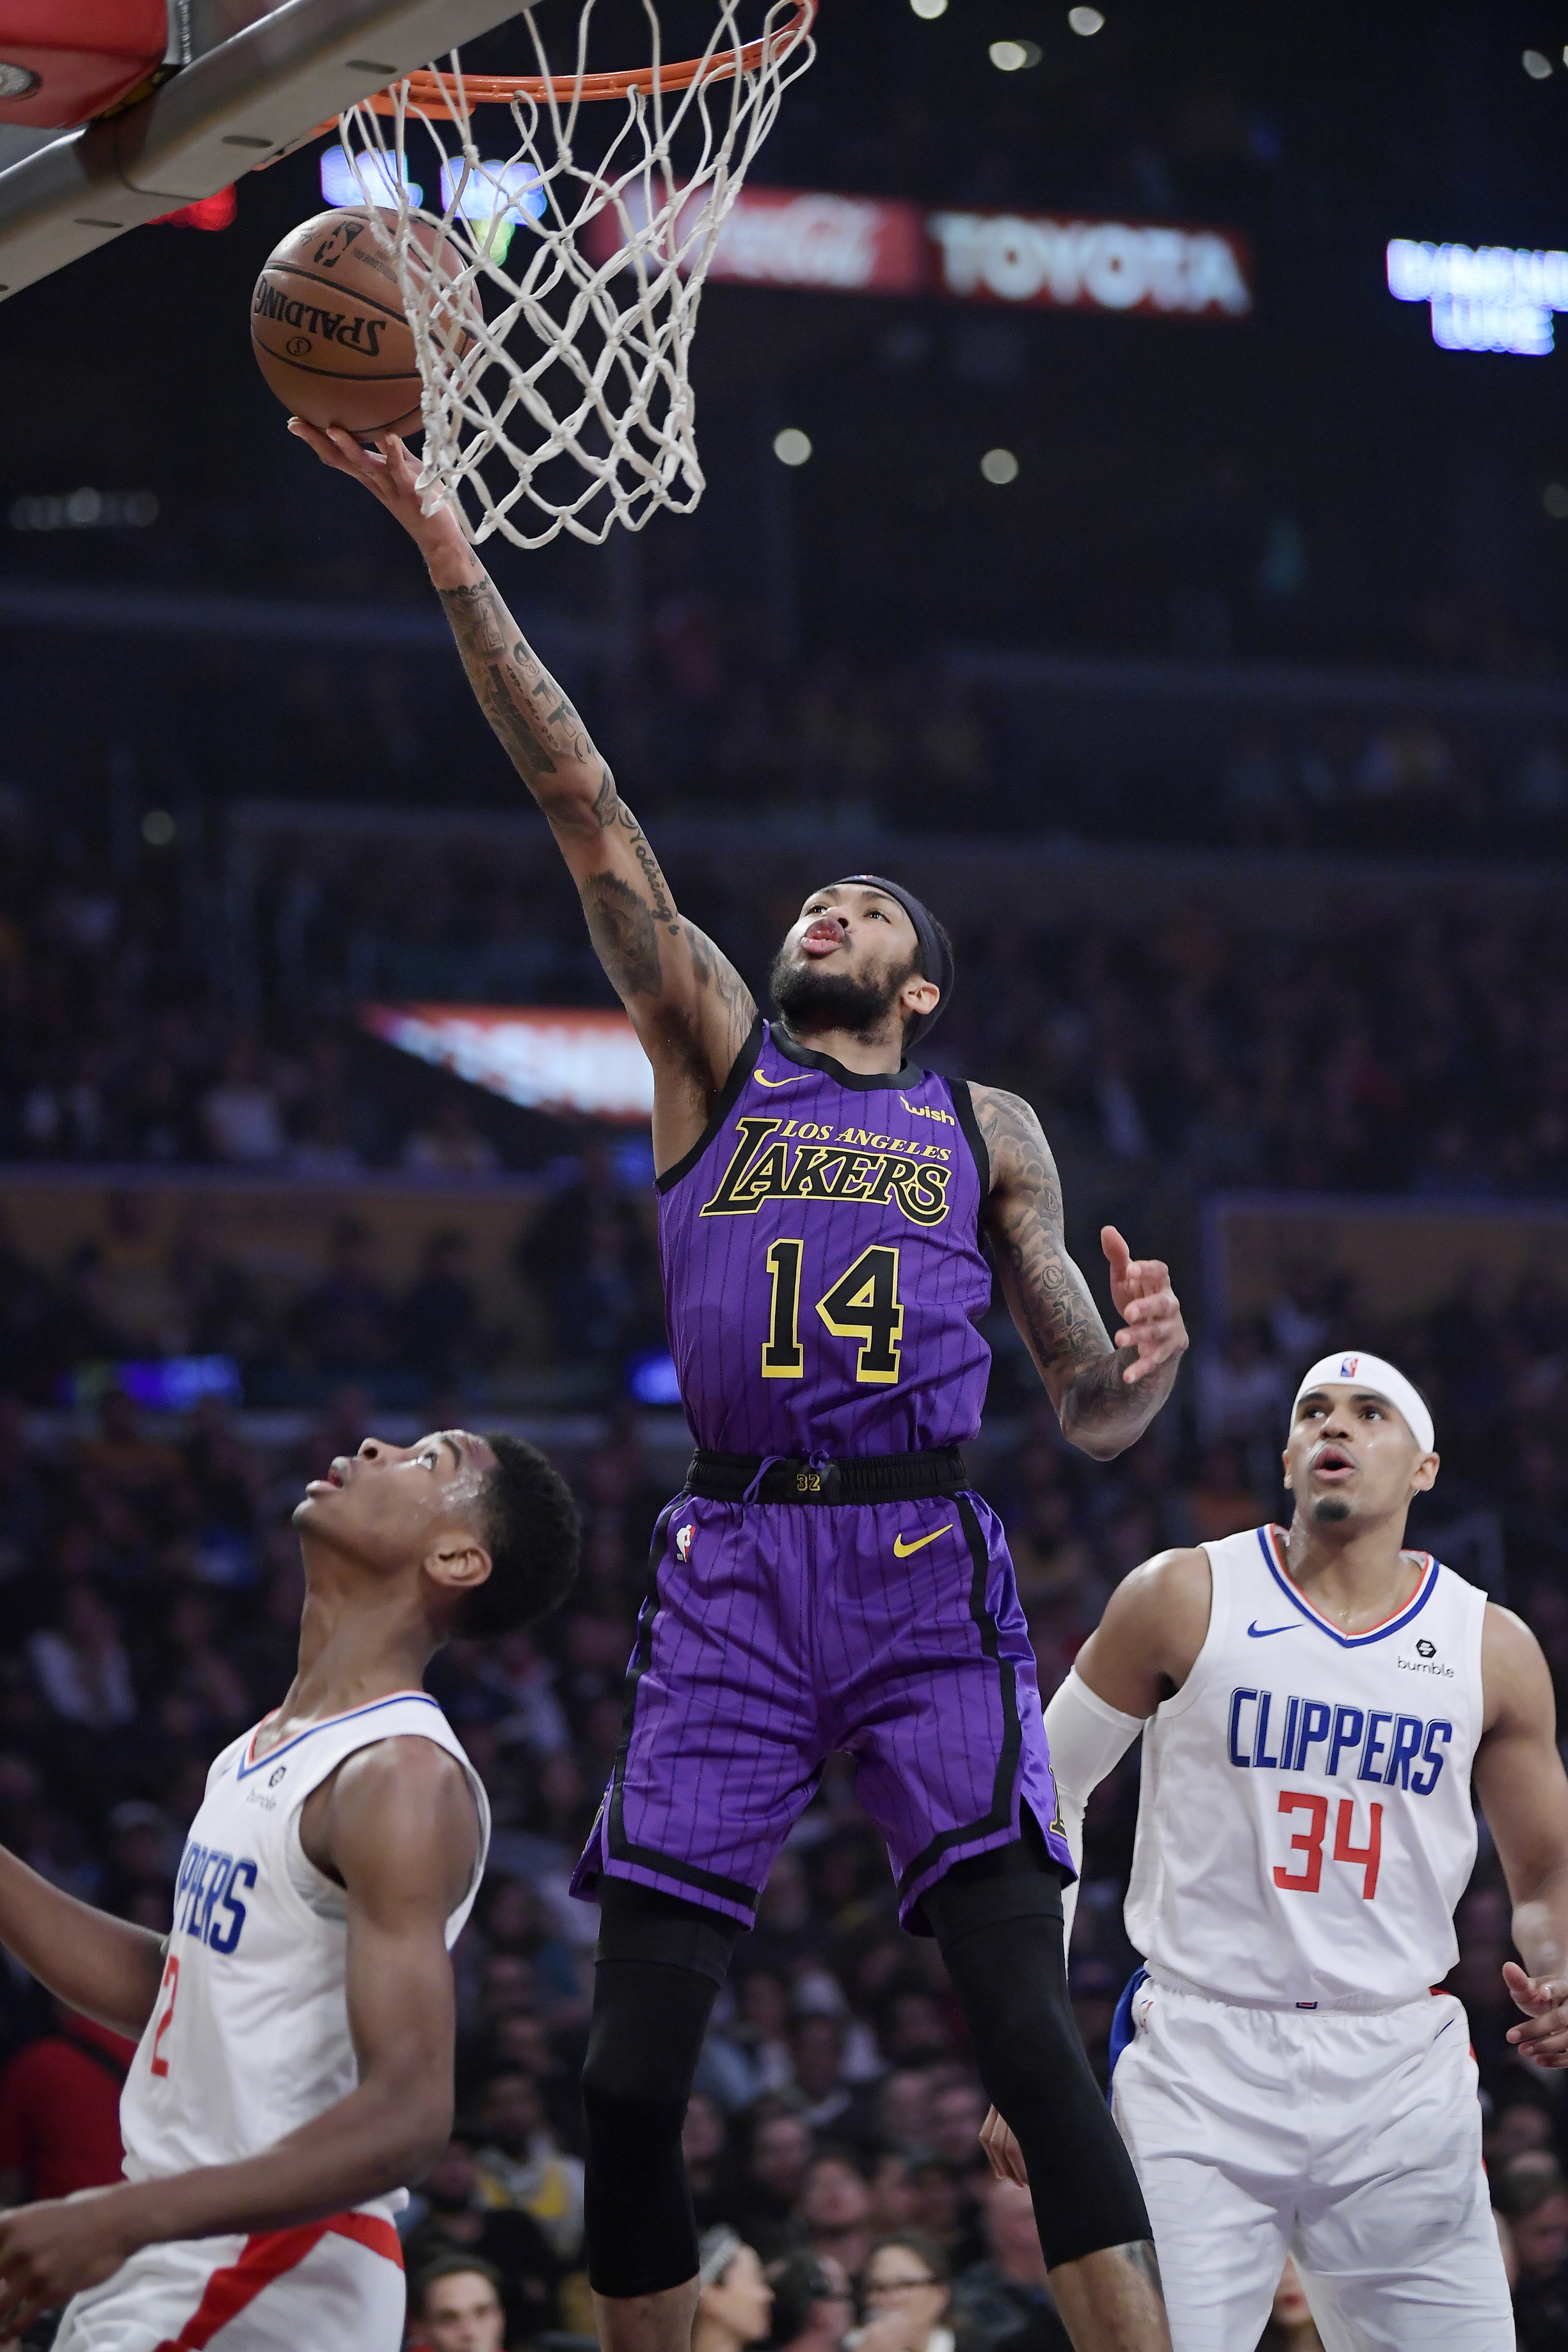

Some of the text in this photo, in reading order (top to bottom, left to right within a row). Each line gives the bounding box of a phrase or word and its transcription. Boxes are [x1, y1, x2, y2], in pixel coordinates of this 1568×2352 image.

[255, 277, 387, 356] SPALDING
[780, 1120, 952, 1161] LOS ANGELES
[900, 1096, 955, 1126] wish
[698, 1117, 952, 1227] LAKERS
[762, 1238, 904, 1384] 14
[797, 1474, 820, 1491] 32
[1398, 1656, 1454, 1678] bumble
[1228, 1687, 1452, 1796] CLIPPERS
[176, 1837, 257, 1955] PPERS
[1274, 1791, 1383, 1900] 34
[150, 1955, 180, 2078] 2
